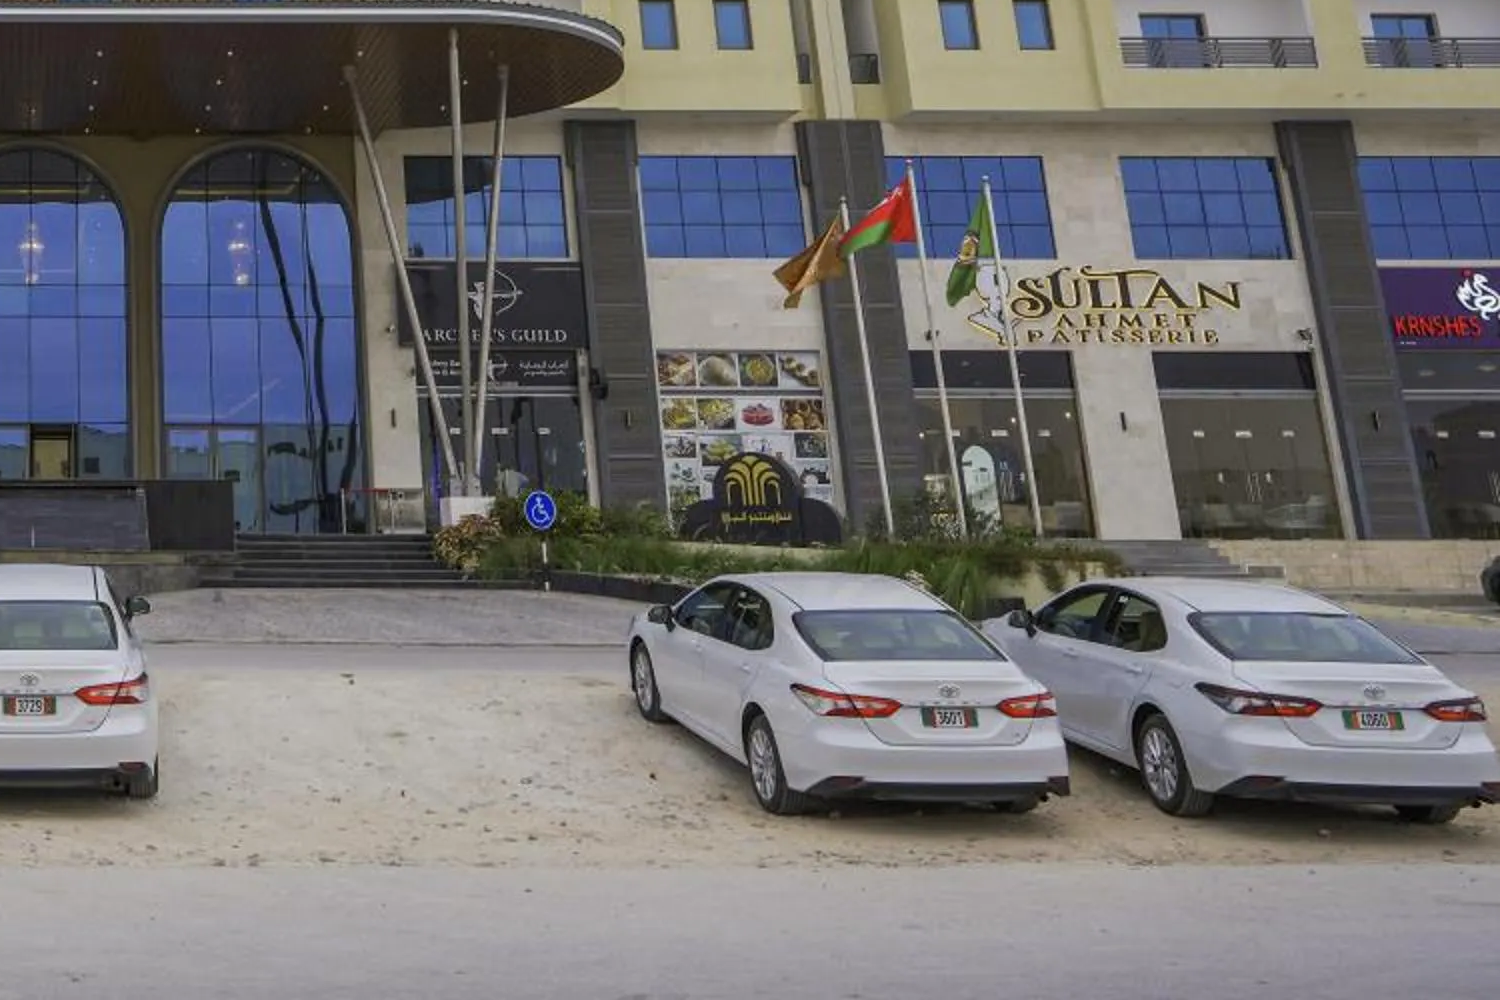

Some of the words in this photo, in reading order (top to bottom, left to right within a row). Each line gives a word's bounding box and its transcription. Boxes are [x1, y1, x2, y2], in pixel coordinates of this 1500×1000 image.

[1010, 265, 1242, 319] SULTAN
[1054, 313, 1198, 329] AHMET
[420, 328, 507, 343] ARCE'S
[511, 328, 568, 343] GUILD
[1027, 329, 1220, 344] PATISSERIE
